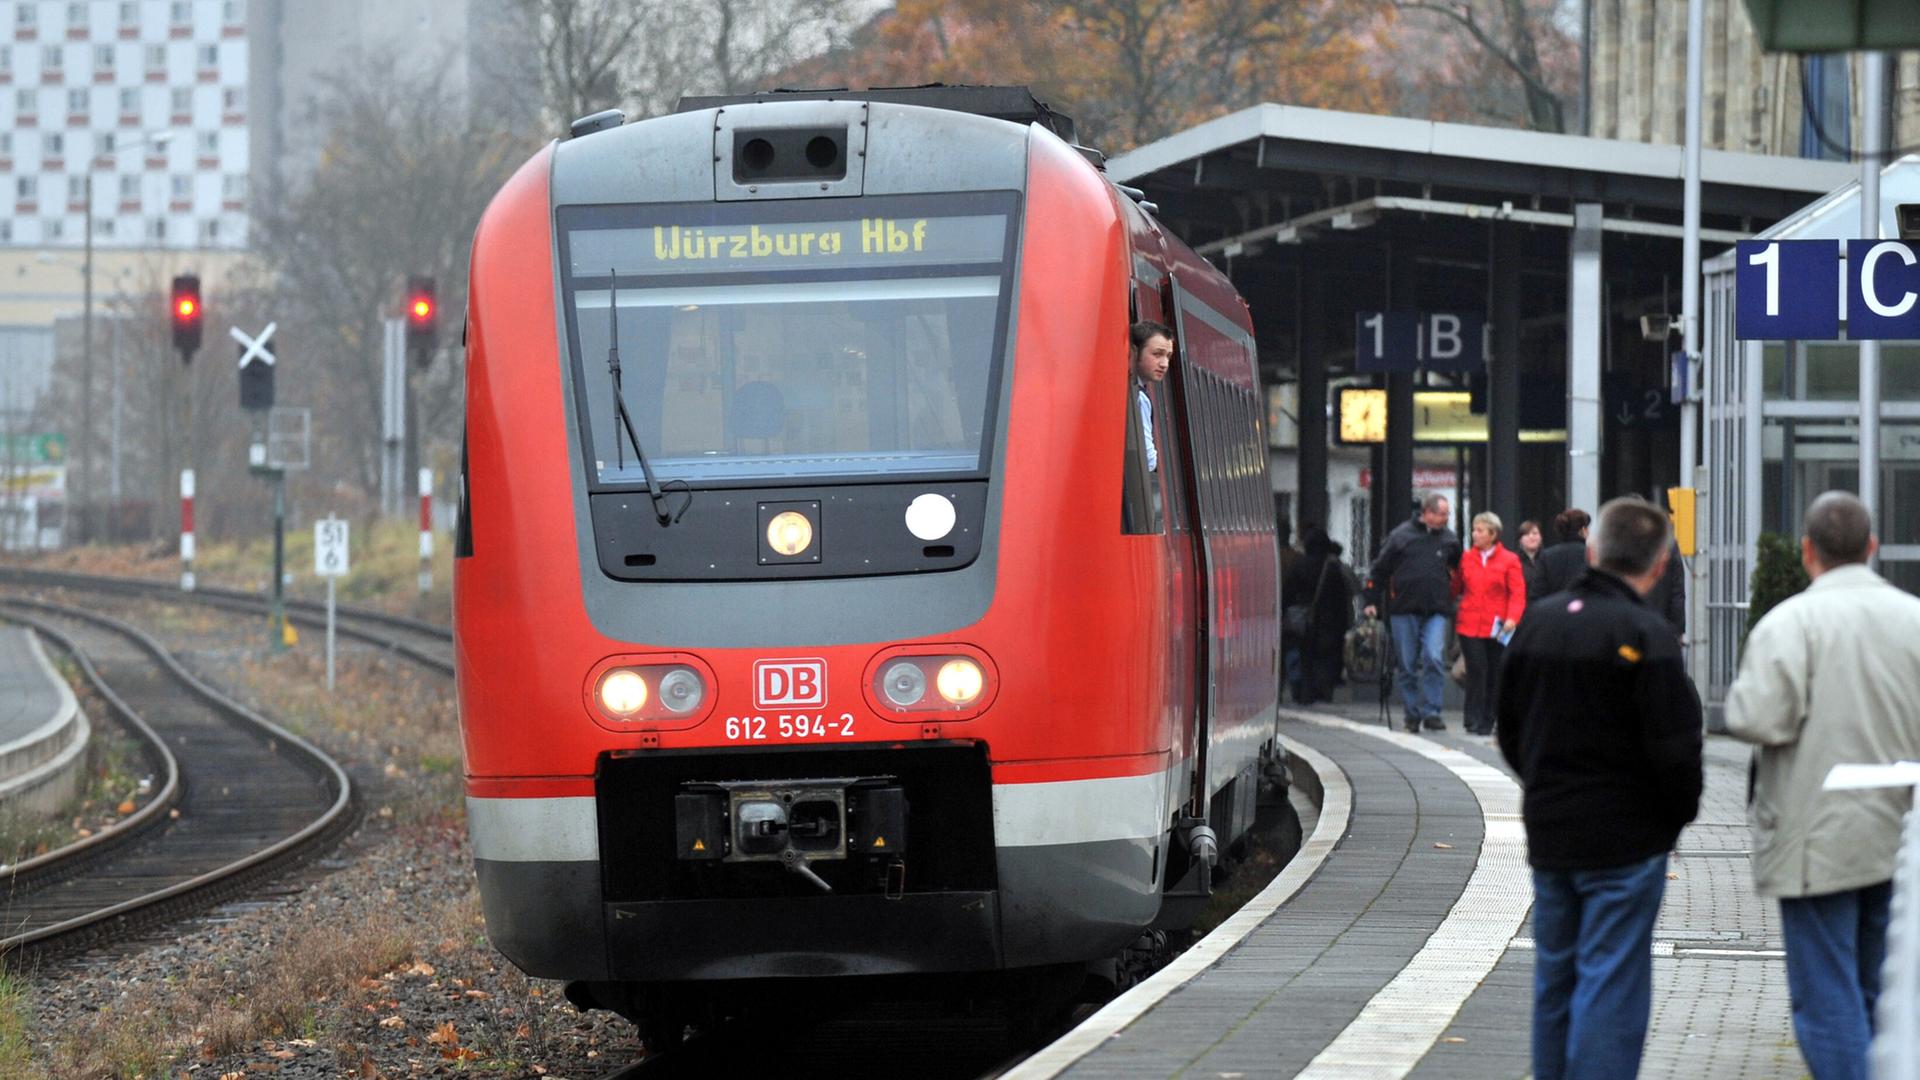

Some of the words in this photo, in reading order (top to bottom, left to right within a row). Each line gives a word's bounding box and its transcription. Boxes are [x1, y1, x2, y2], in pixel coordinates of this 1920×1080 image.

[654, 225, 841, 260] Würzburg
[861, 218, 928, 253] Hbf
[1749, 242, 1780, 316] 1
[1860, 241, 1919, 318] C
[1364, 313, 1384, 359] 1
[1430, 313, 1462, 359] B
[1644, 389, 1662, 419] 2
[322, 522, 344, 547] 51
[324, 548, 340, 569] 6
[762, 665, 819, 702] DB
[725, 716, 767, 740] 612
[778, 713, 855, 738] 594-2
